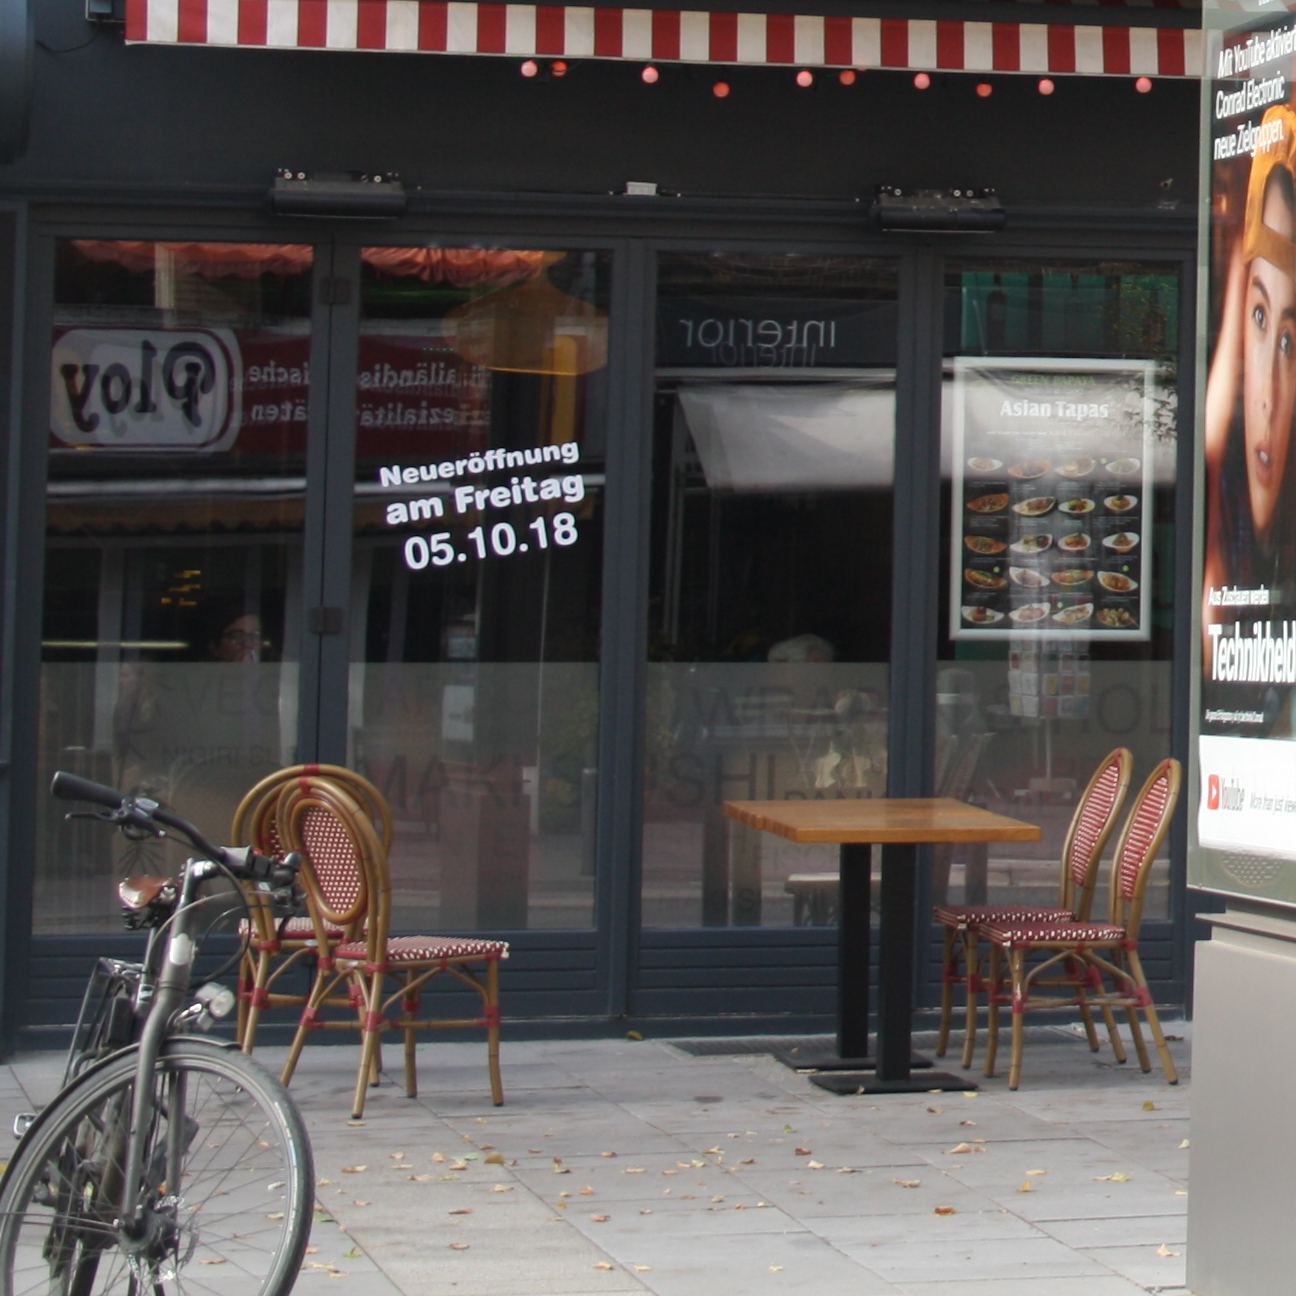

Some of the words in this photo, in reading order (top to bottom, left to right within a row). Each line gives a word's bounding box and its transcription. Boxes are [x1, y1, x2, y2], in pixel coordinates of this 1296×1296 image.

[1217, 49, 1233, 79] Mit
[1233, 36, 1265, 73] YouTube
[1216, 80, 1246, 119] Conrad
[1247, 71, 1285, 110] Electronic
[1214, 133, 1235, 160] neue
[1000, 399, 1051, 417] Asian
[1055, 401, 1109, 421] Tapas
[379, 441, 580, 487] Neueröffnung
[386, 496, 444, 525] am
[454, 474, 585, 514] Freitag
[404, 512, 579, 571] 05.10.18
[1221, 777, 1245, 811] YouTube
